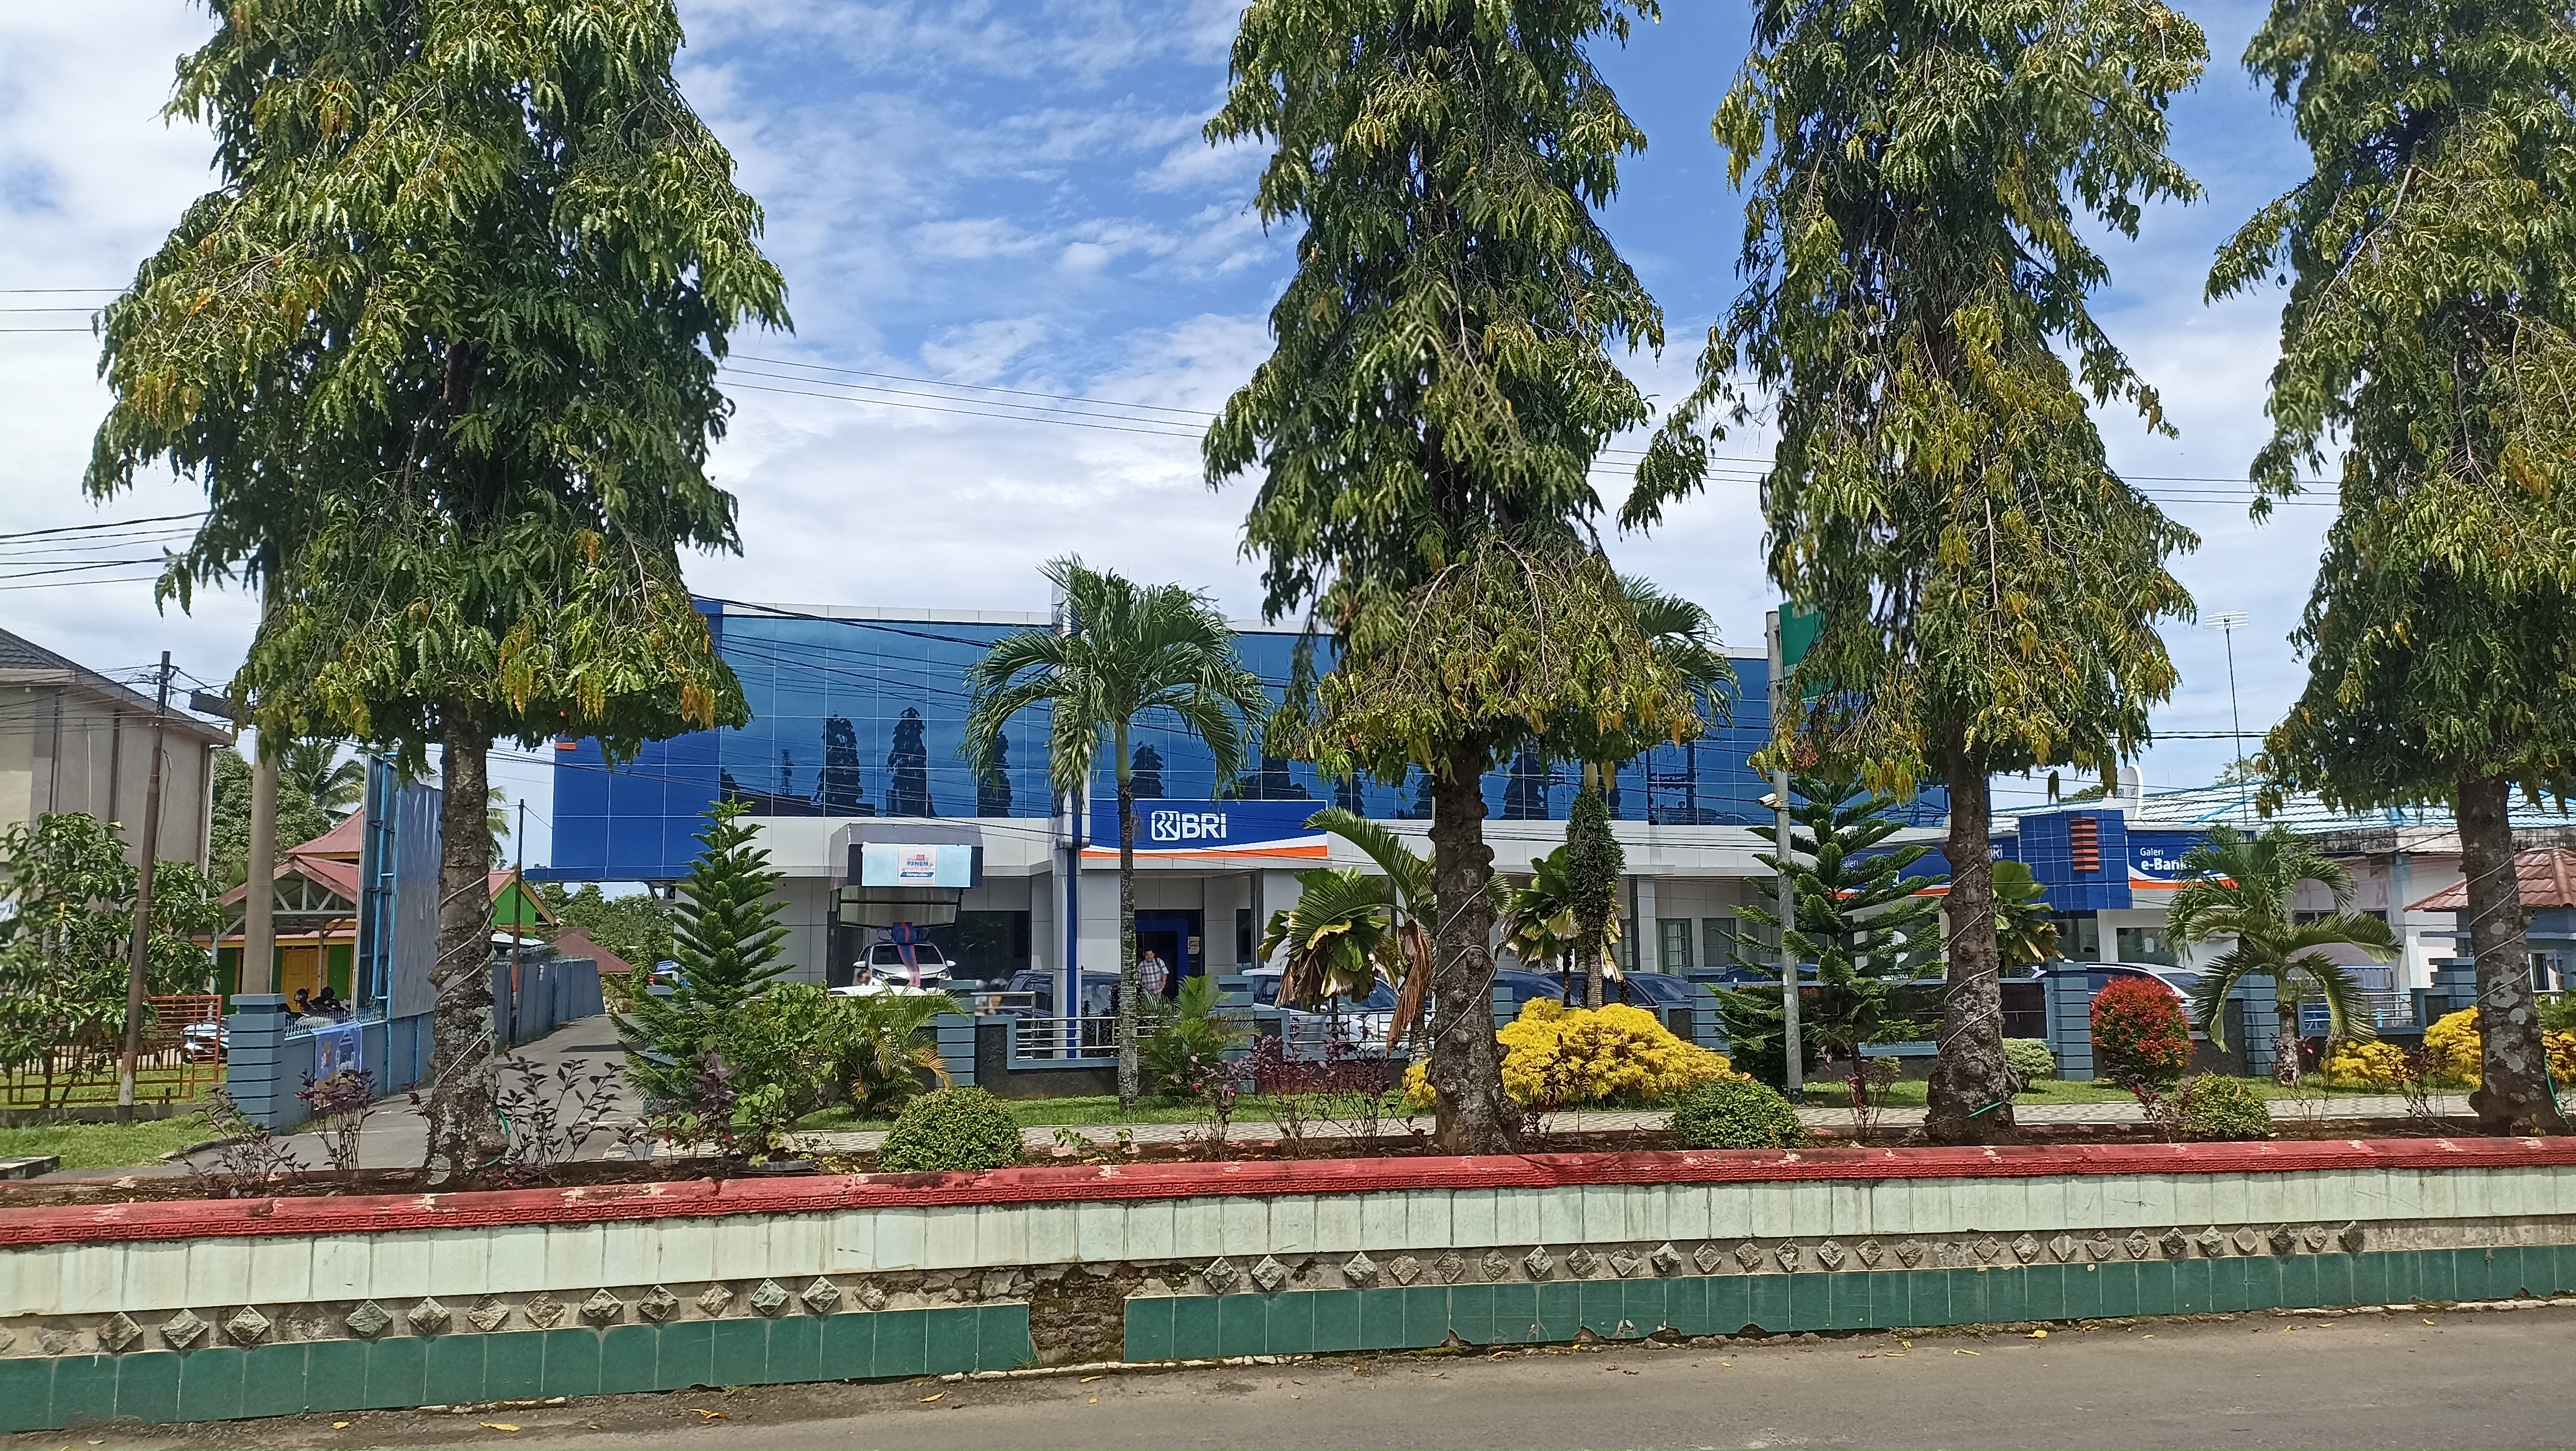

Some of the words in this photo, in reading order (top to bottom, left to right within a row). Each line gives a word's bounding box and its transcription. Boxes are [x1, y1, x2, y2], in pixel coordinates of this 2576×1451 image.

[1182, 813, 1227, 839] BRI
[2140, 847, 2164, 856] Galeri
[1842, 857, 1858, 868] aleri
